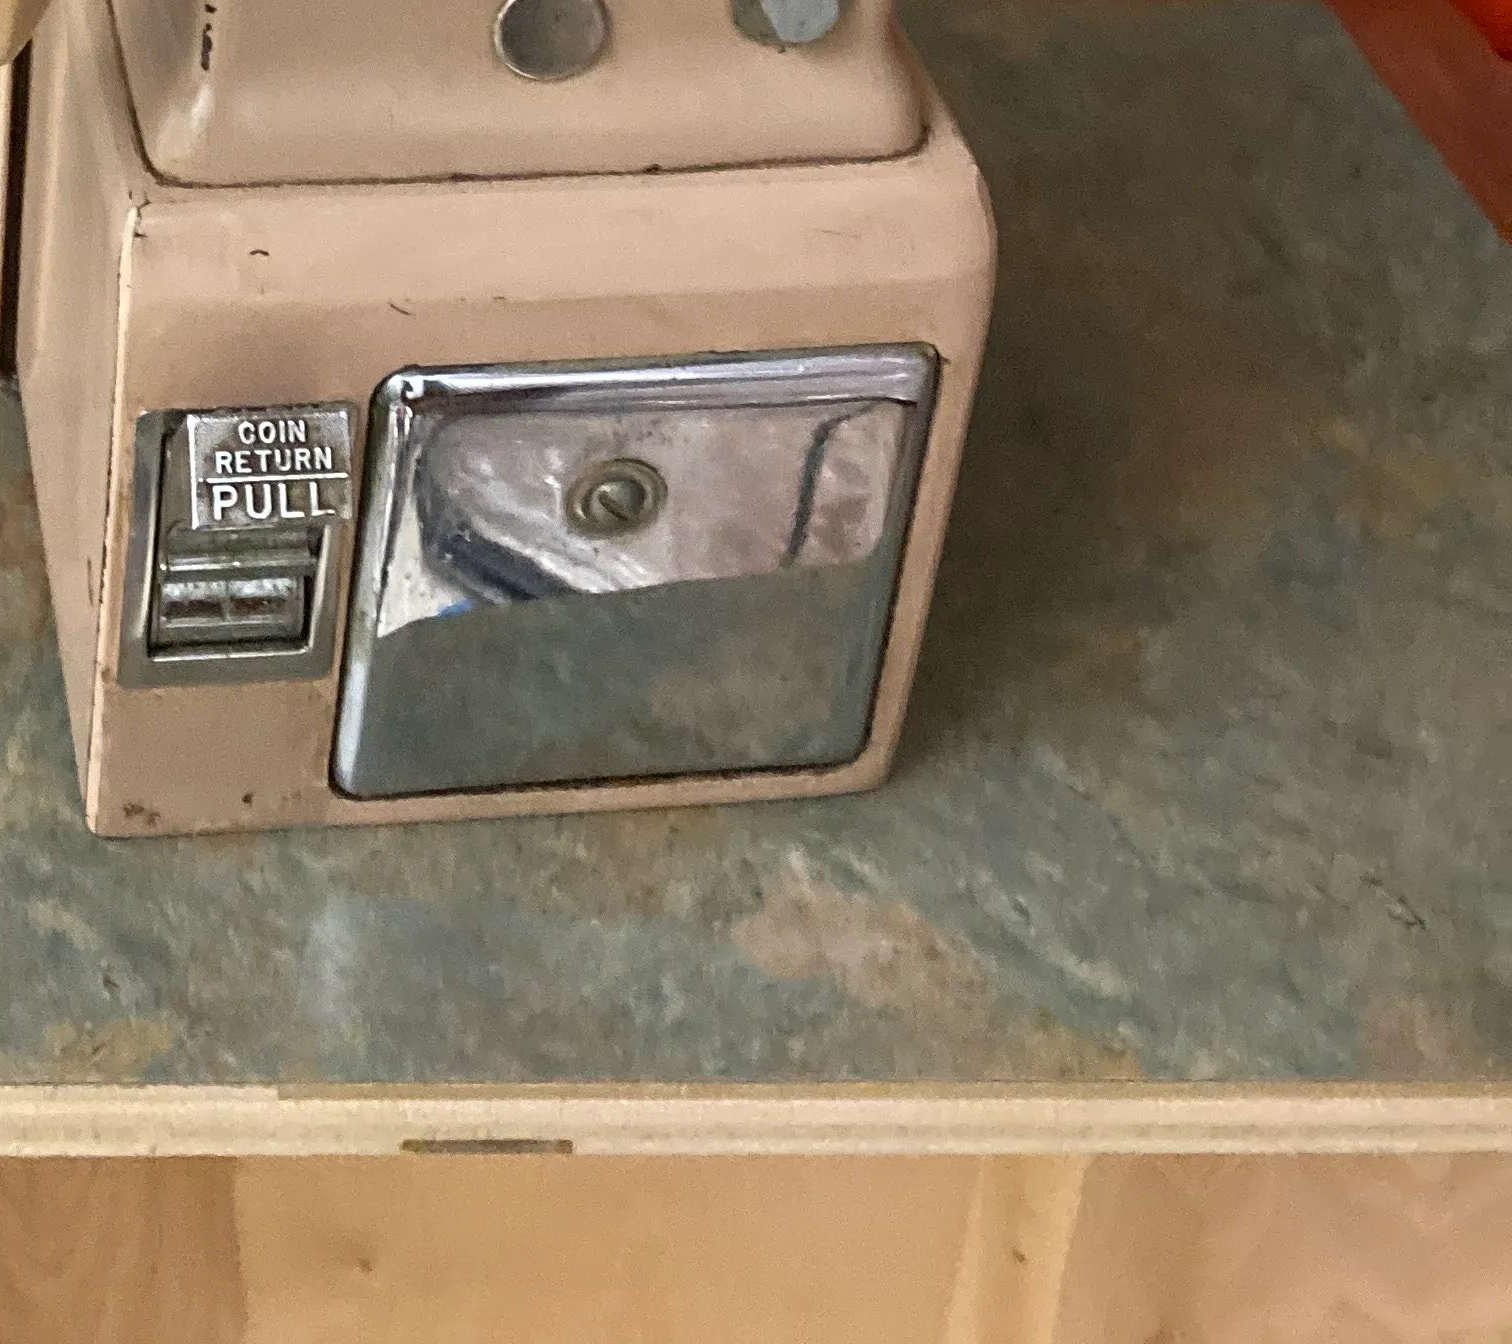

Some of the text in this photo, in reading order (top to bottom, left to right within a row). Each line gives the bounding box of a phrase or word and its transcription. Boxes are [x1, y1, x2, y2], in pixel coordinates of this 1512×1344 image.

[238, 418, 307, 445] COIN
[214, 446, 332, 474] RETURN
[211, 481, 337, 521] PULL
